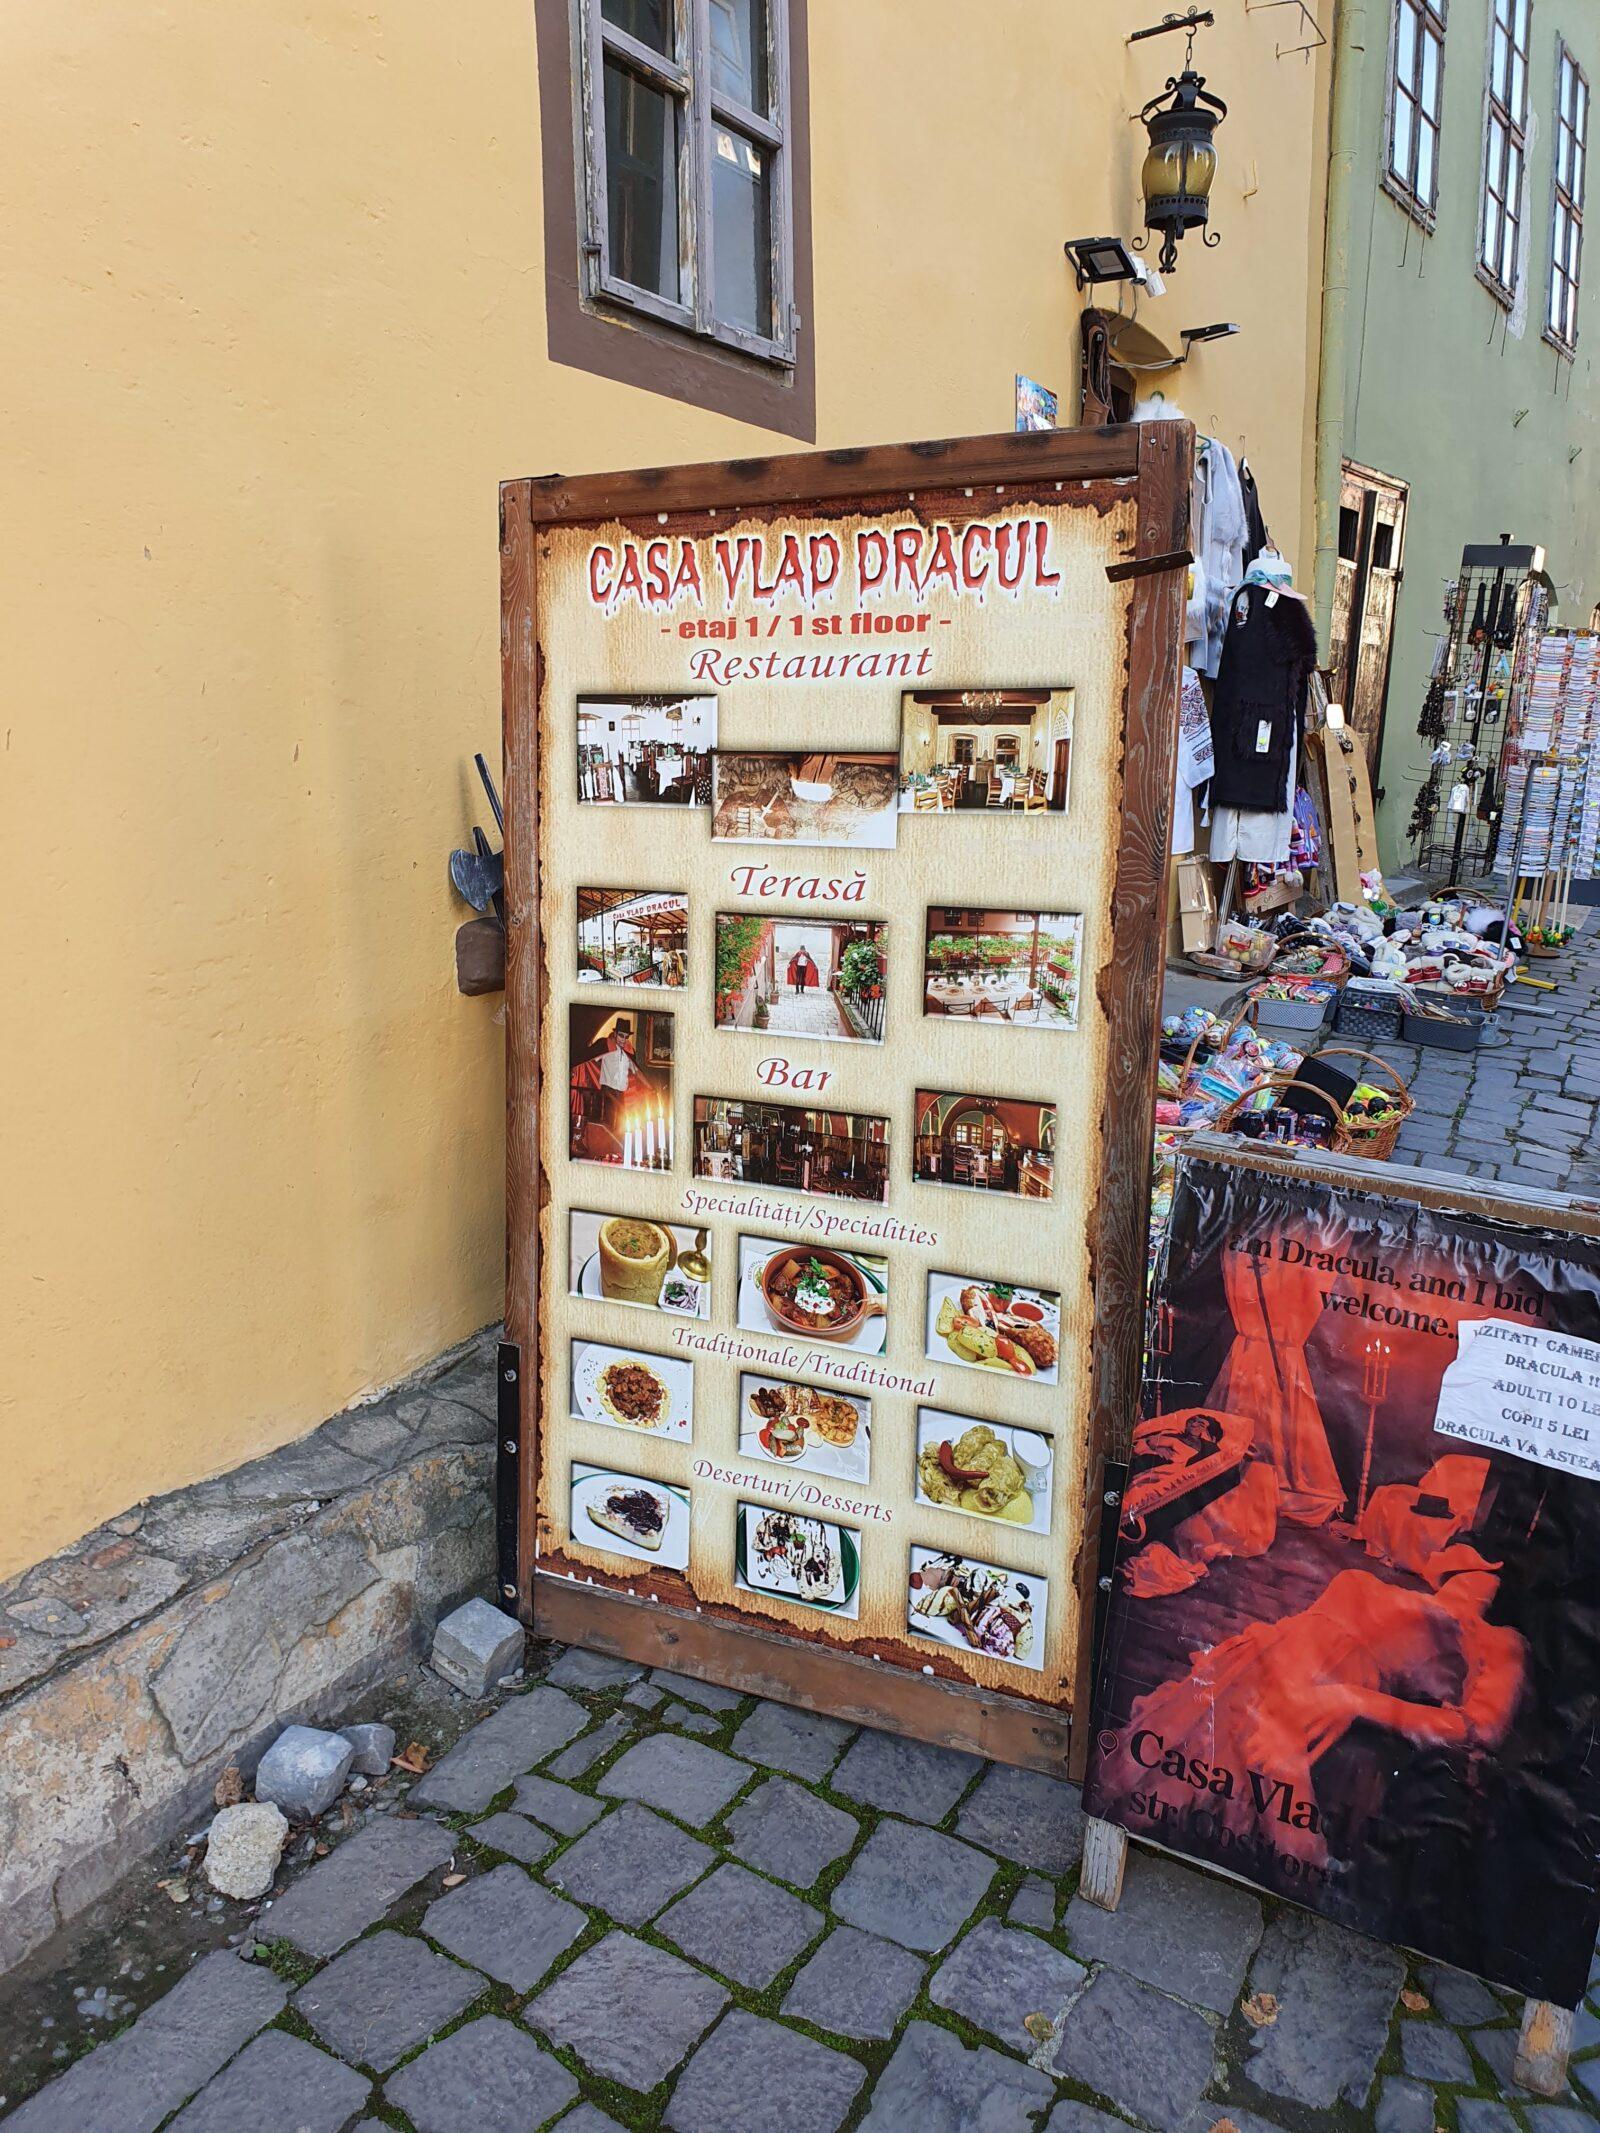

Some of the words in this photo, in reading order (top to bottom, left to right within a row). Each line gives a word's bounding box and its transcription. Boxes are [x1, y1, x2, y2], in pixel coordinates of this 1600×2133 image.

[589, 541, 702, 614] CASA
[716, 533, 840, 608] VLAD
[858, 520, 1061, 606] DRACUL
[679, 616, 738, 640] etaj
[745, 616, 759, 637] 1
[789, 614, 804, 636] 1
[811, 615, 843, 636] st
[850, 612, 932, 635] floor
[690, 647, 933, 687] Restaurant
[730, 864, 867, 901] Terasă
[646, 898, 681, 912] DRACUL
[756, 1057, 832, 1091] Bar
[1278, 1237, 1401, 1290] Dracula,
[1408, 1271, 1466, 1302] and
[1472, 1278, 1489, 1306] I
[1494, 1282, 1545, 1318] bid
[1504, 1353, 1583, 1384] DRACULA
[1491, 1378, 1553, 1404] ADULTI
[1435, 1418, 1511, 1448] DRACULA
[1517, 1438, 1539, 1457] VA
[1501, 1407, 1543, 1430] COPII
[1547, 1420, 1558, 1433] 5
[1562, 1423, 1590, 1442] LEI
[1130, 1729, 1235, 1800] Casa
